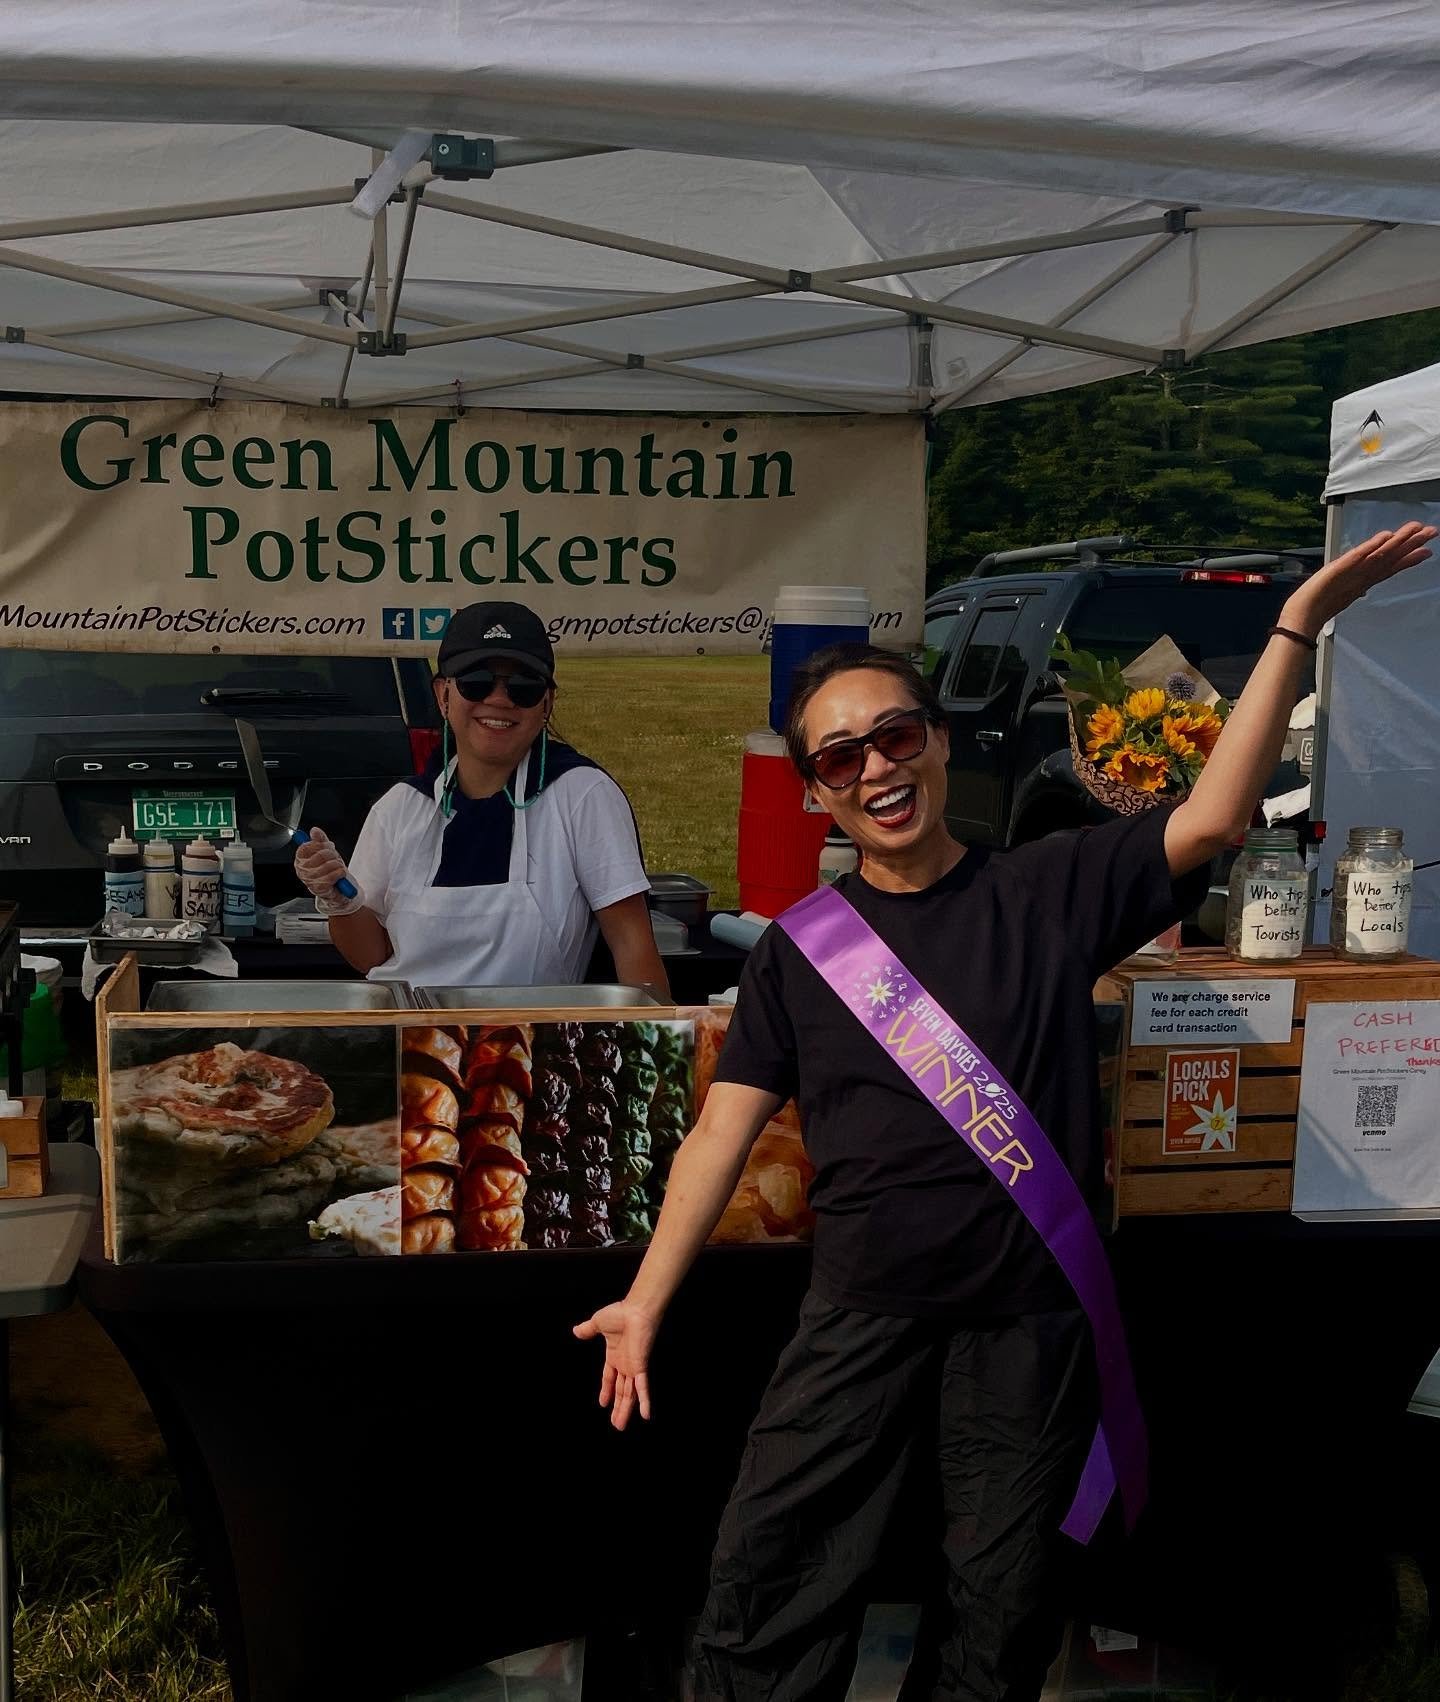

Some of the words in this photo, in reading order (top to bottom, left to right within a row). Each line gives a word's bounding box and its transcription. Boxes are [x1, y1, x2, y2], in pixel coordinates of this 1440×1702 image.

[60, 415, 338, 491] Green
[368, 418, 795, 500] Mountain
[183, 506, 677, 586] PotStickers
[143, 802, 180, 827] GSE
[193, 801, 227, 826] 171
[1251, 885, 1279, 900] Who
[1353, 880, 1381, 896] Who
[1251, 924, 1301, 941] Tourists
[1360, 916, 1404, 933] Locals
[1151, 992, 1169, 1002] We
[1191, 991, 1229, 1004] charge
[1231, 991, 1271, 1002] service
[1151, 1007, 1168, 1017] fee
[1170, 1007, 1185, 1017] for
[1188, 1007, 1214, 1017] each
[1217, 1006, 1248, 1017] credit
[1353, 1012, 1413, 1028] CASH
[908, 997, 944, 1034] SEVEN
[935, 1027, 981, 1074] DAYSIES
[1149, 1023, 1173, 1033] card
[1176, 1022, 1237, 1033] transaction
[1173, 1060, 1230, 1080] LOCALS
[886, 1010, 1034, 1187] WINNER
[1171, 1080, 1210, 1102] PICK
